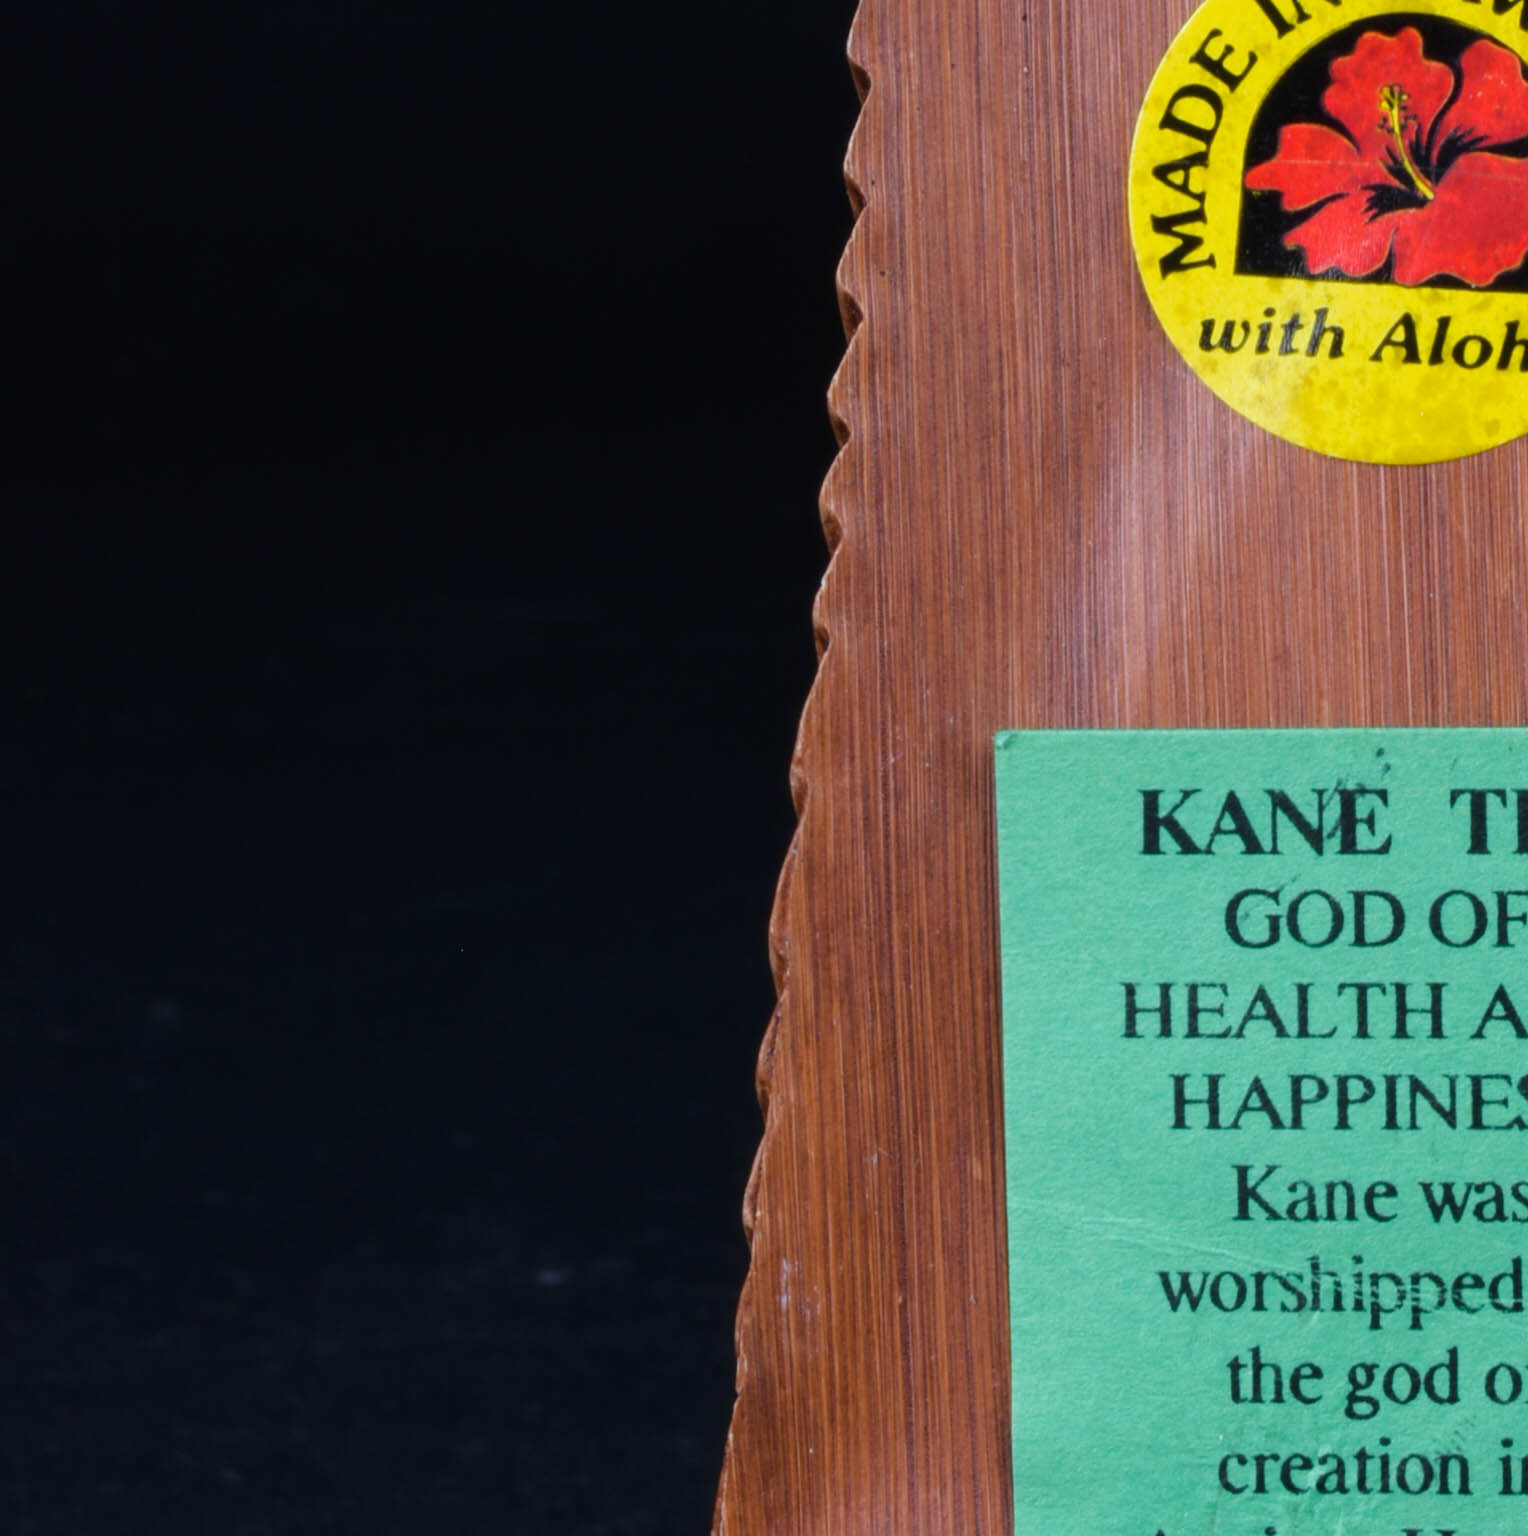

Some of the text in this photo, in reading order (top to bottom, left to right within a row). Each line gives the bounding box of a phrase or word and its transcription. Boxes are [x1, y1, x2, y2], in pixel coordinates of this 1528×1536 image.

[1151, 29, 1257, 279] MADE
[1200, 309, 1343, 358] with
[1142, 787, 1391, 855] KANE
[1226, 889, 1405, 948] GOD
[1125, 983, 1444, 1038] HEALTH
[1236, 1166, 1397, 1222] Kane
[1160, 1256, 1523, 1330] worshipped
[1228, 1347, 1323, 1404] the
[1345, 1347, 1459, 1419] god
[1219, 1438, 1470, 1494] creation
